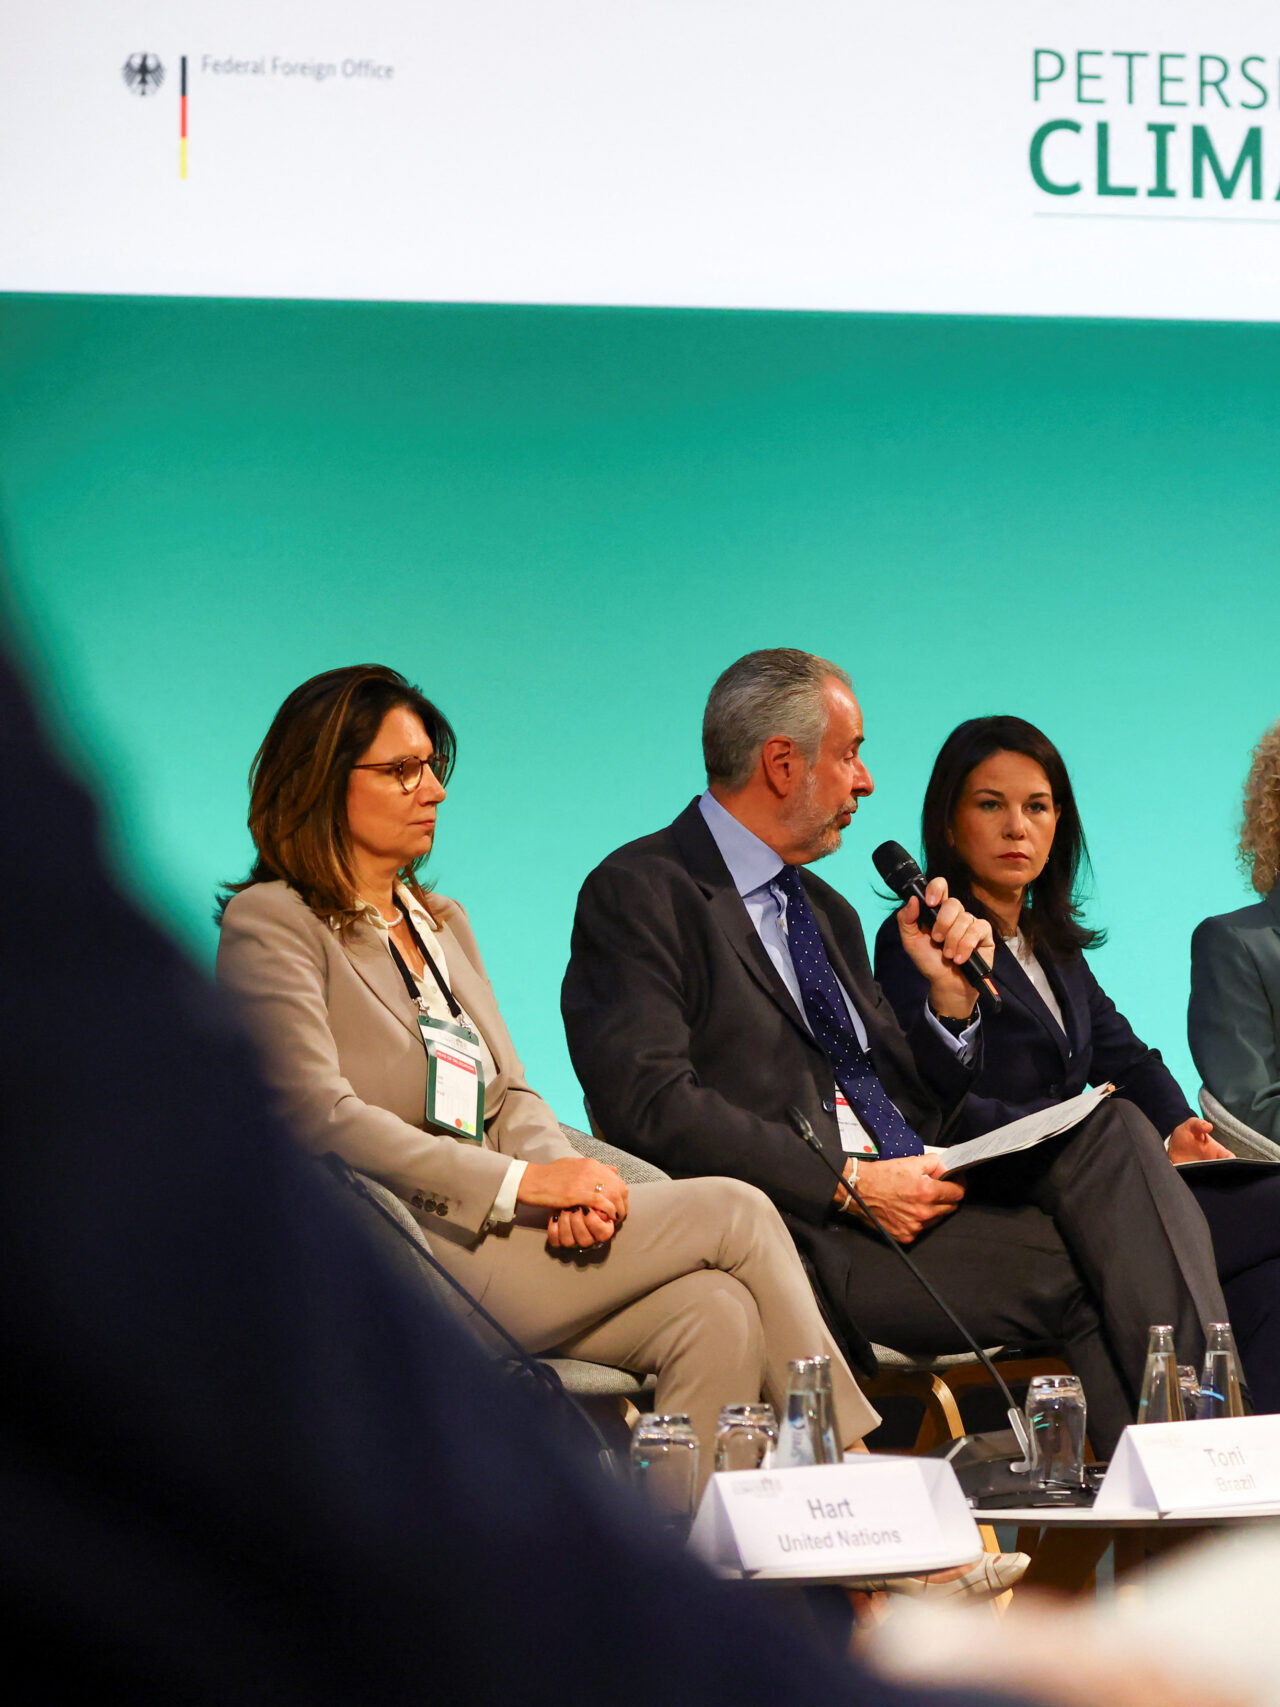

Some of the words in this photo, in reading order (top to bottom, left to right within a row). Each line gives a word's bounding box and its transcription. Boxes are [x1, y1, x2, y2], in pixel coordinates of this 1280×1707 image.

[201, 54, 266, 75] Federal
[271, 57, 337, 81] Foreign
[342, 58, 395, 80] Office
[1203, 1446, 1246, 1467] Toni
[1215, 1474, 1256, 1492] Brazil
[807, 1498, 854, 1519] Hart
[777, 1532, 834, 1552] United
[836, 1528, 902, 1546] Nations
